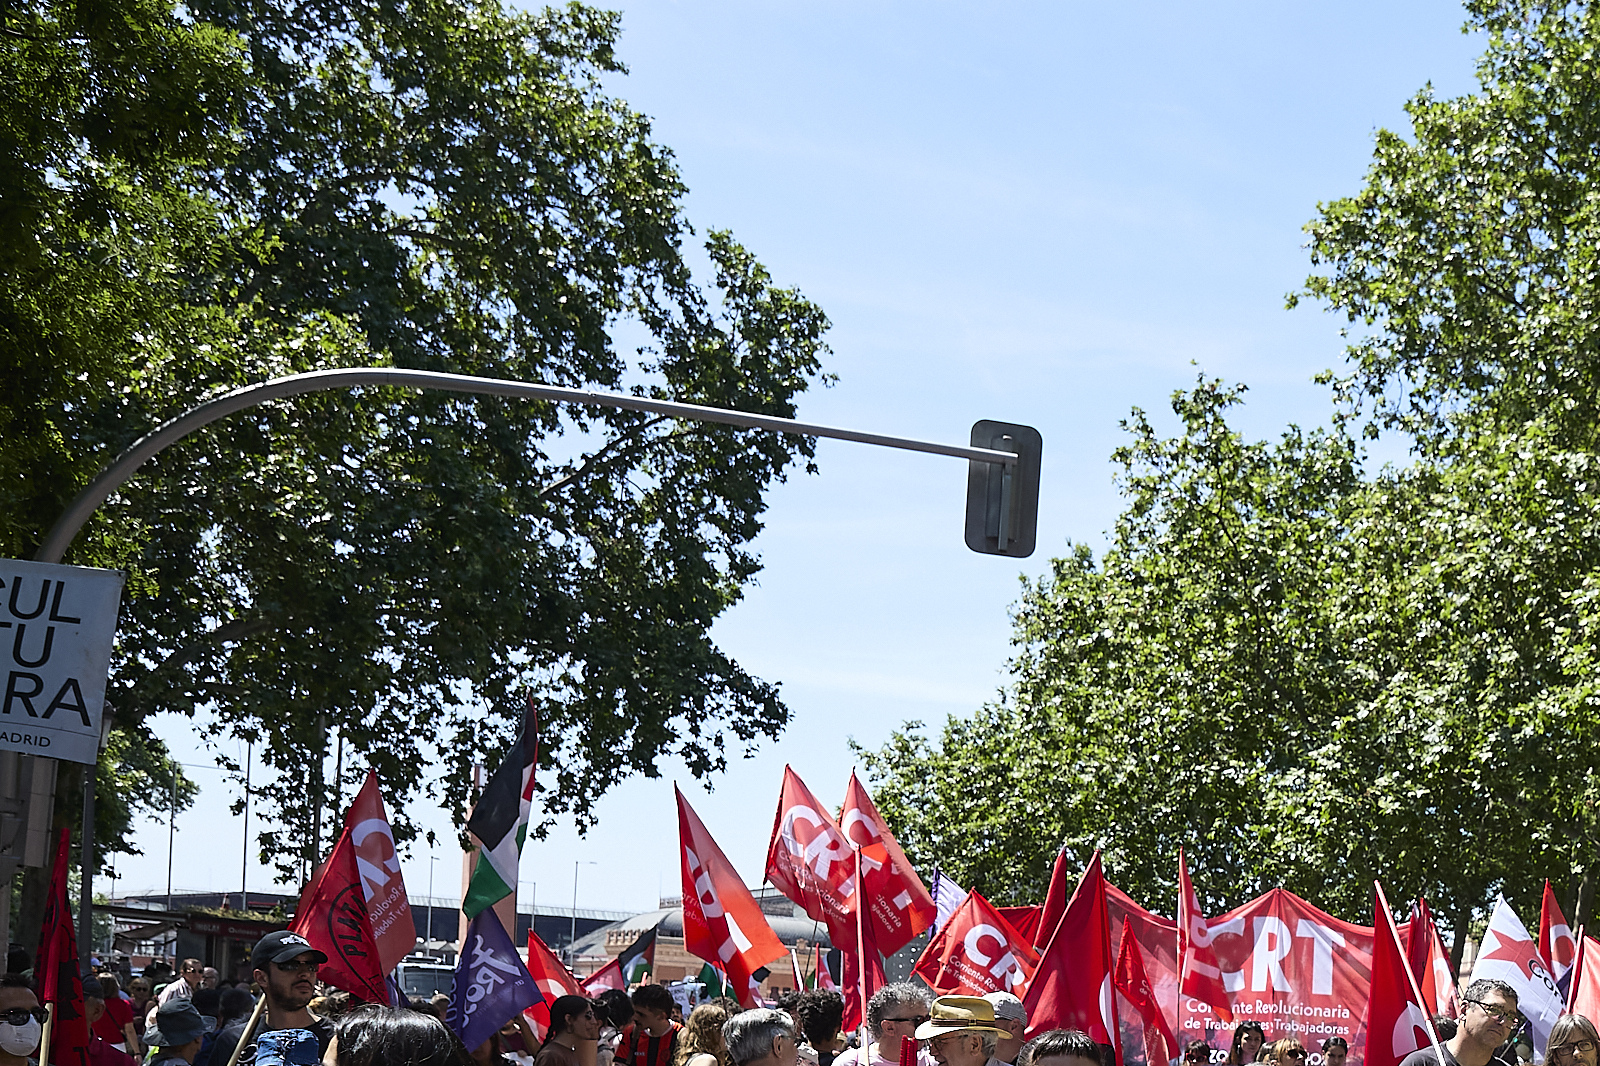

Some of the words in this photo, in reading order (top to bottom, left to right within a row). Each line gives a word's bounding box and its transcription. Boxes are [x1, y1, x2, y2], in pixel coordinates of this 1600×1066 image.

[0, 576, 81, 624] UL
[2, 670, 92, 727] RA
[1184, 1017, 1202, 1031] de
[1274, 1018, 1350, 1036] Trabajadoras
[1255, 999, 1350, 1020] Revolucionaria
